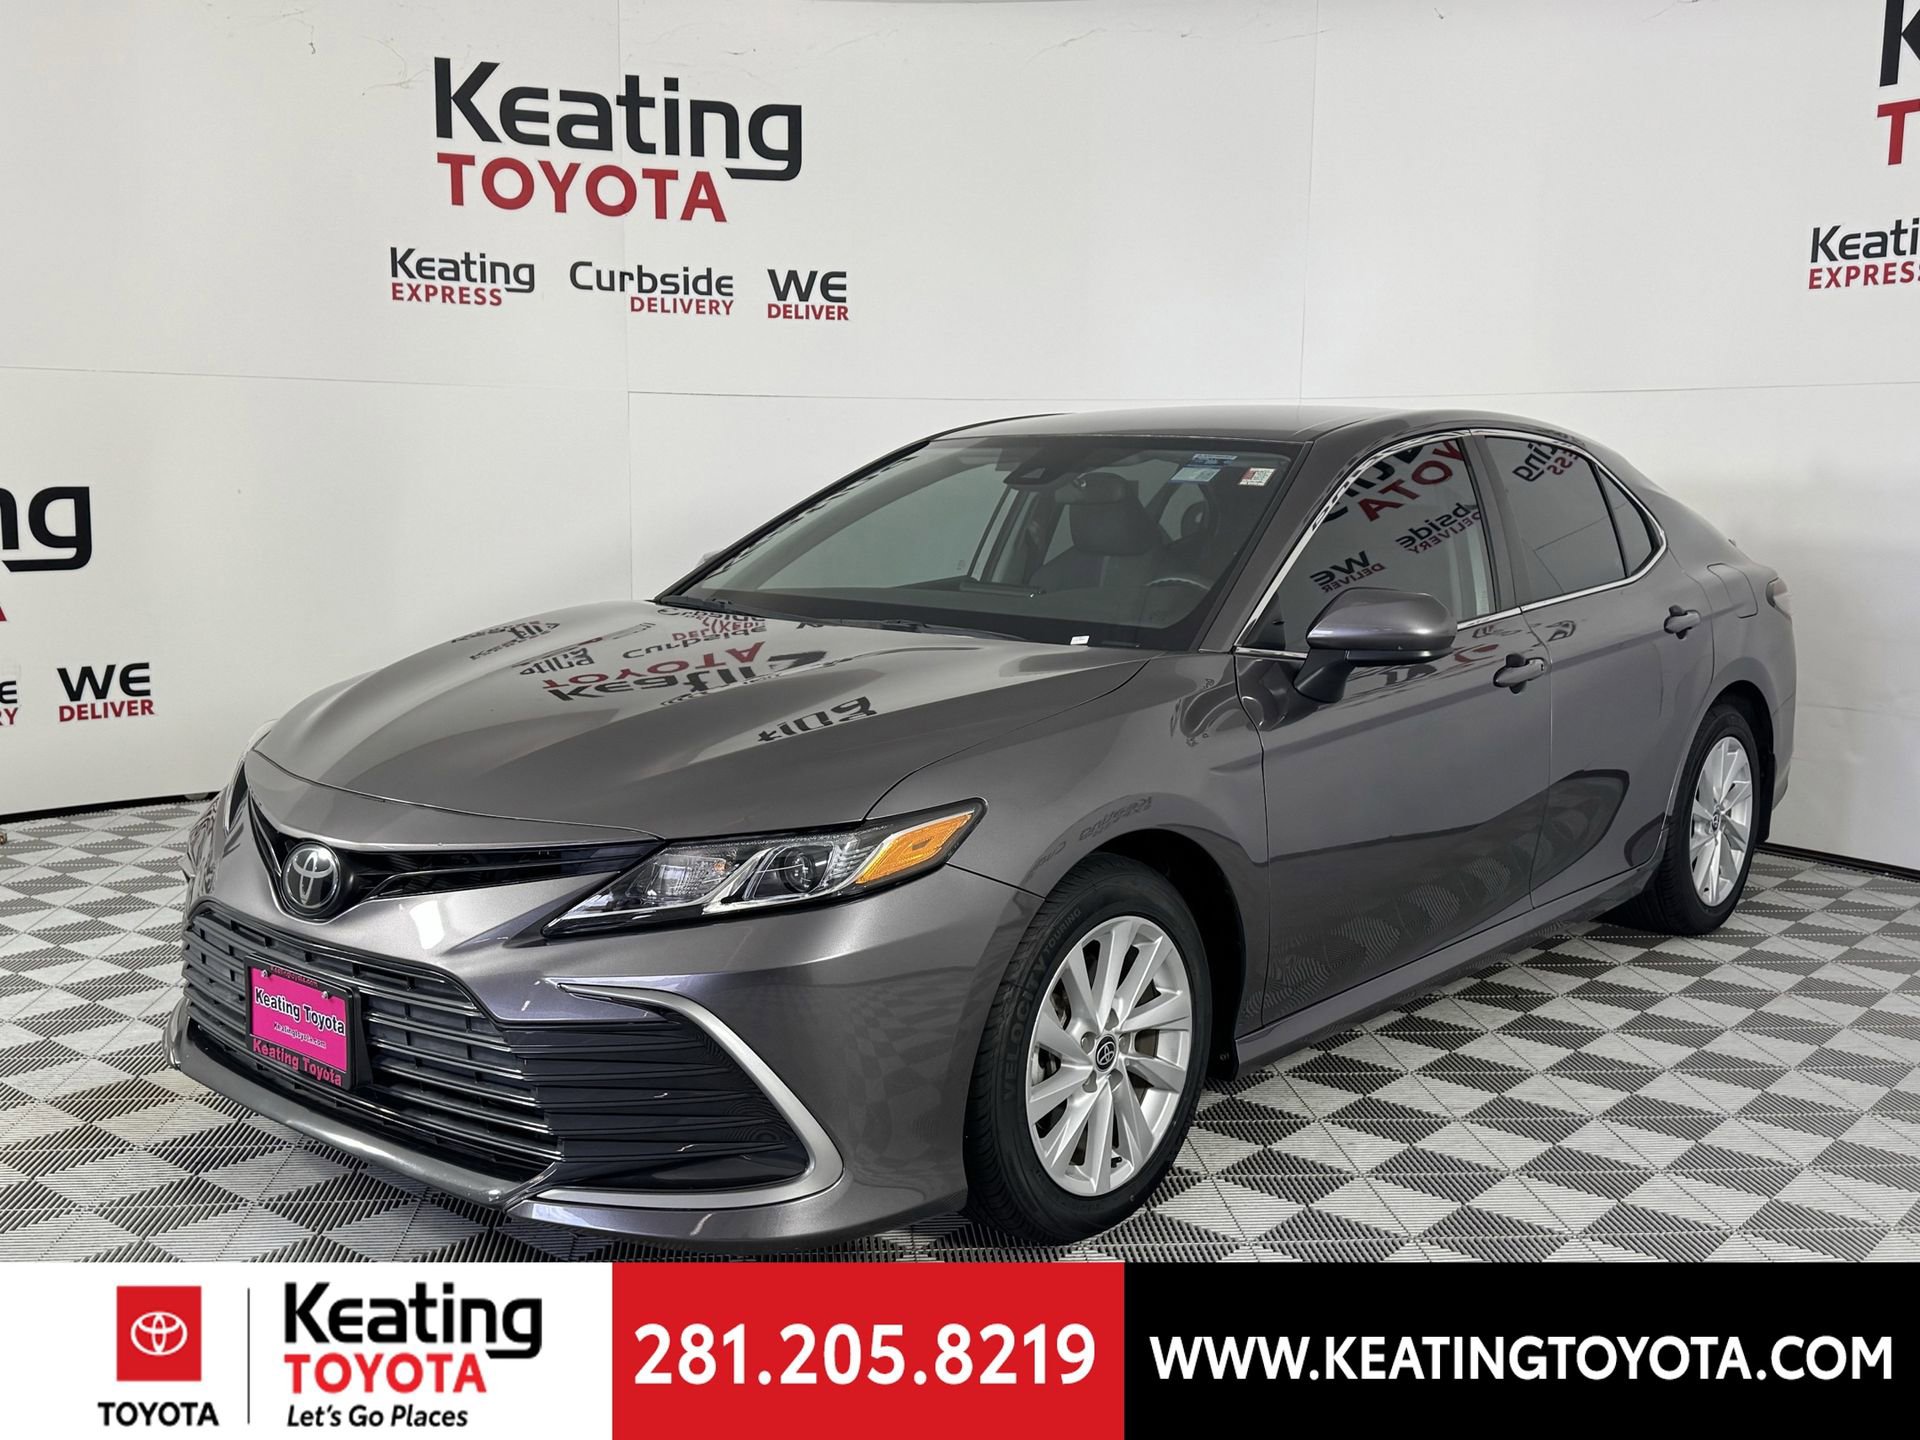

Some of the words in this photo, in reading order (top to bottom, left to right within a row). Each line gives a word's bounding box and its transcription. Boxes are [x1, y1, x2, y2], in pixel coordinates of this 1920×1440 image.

[434, 57, 802, 181] Keating
[437, 152, 727, 223] TOYOTA
[1810, 217, 1920, 263] Keati
[390, 247, 535, 293] Keating
[569, 261, 734, 297] Curbside
[767, 268, 847, 303] WE
[1808, 260, 1920, 289] EXPRES
[391, 282, 503, 306] EXPRESS
[630, 296, 734, 316] DELIVERY
[767, 302, 849, 321] DELIVER
[57, 662, 152, 702] WE
[59, 699, 155, 722] DELIVER
[255, 986, 300, 1022] Keating
[303, 1005, 346, 1037] Toyota
[253, 1038, 300, 1069] Keating
[302, 1057, 342, 1087] Toyota
